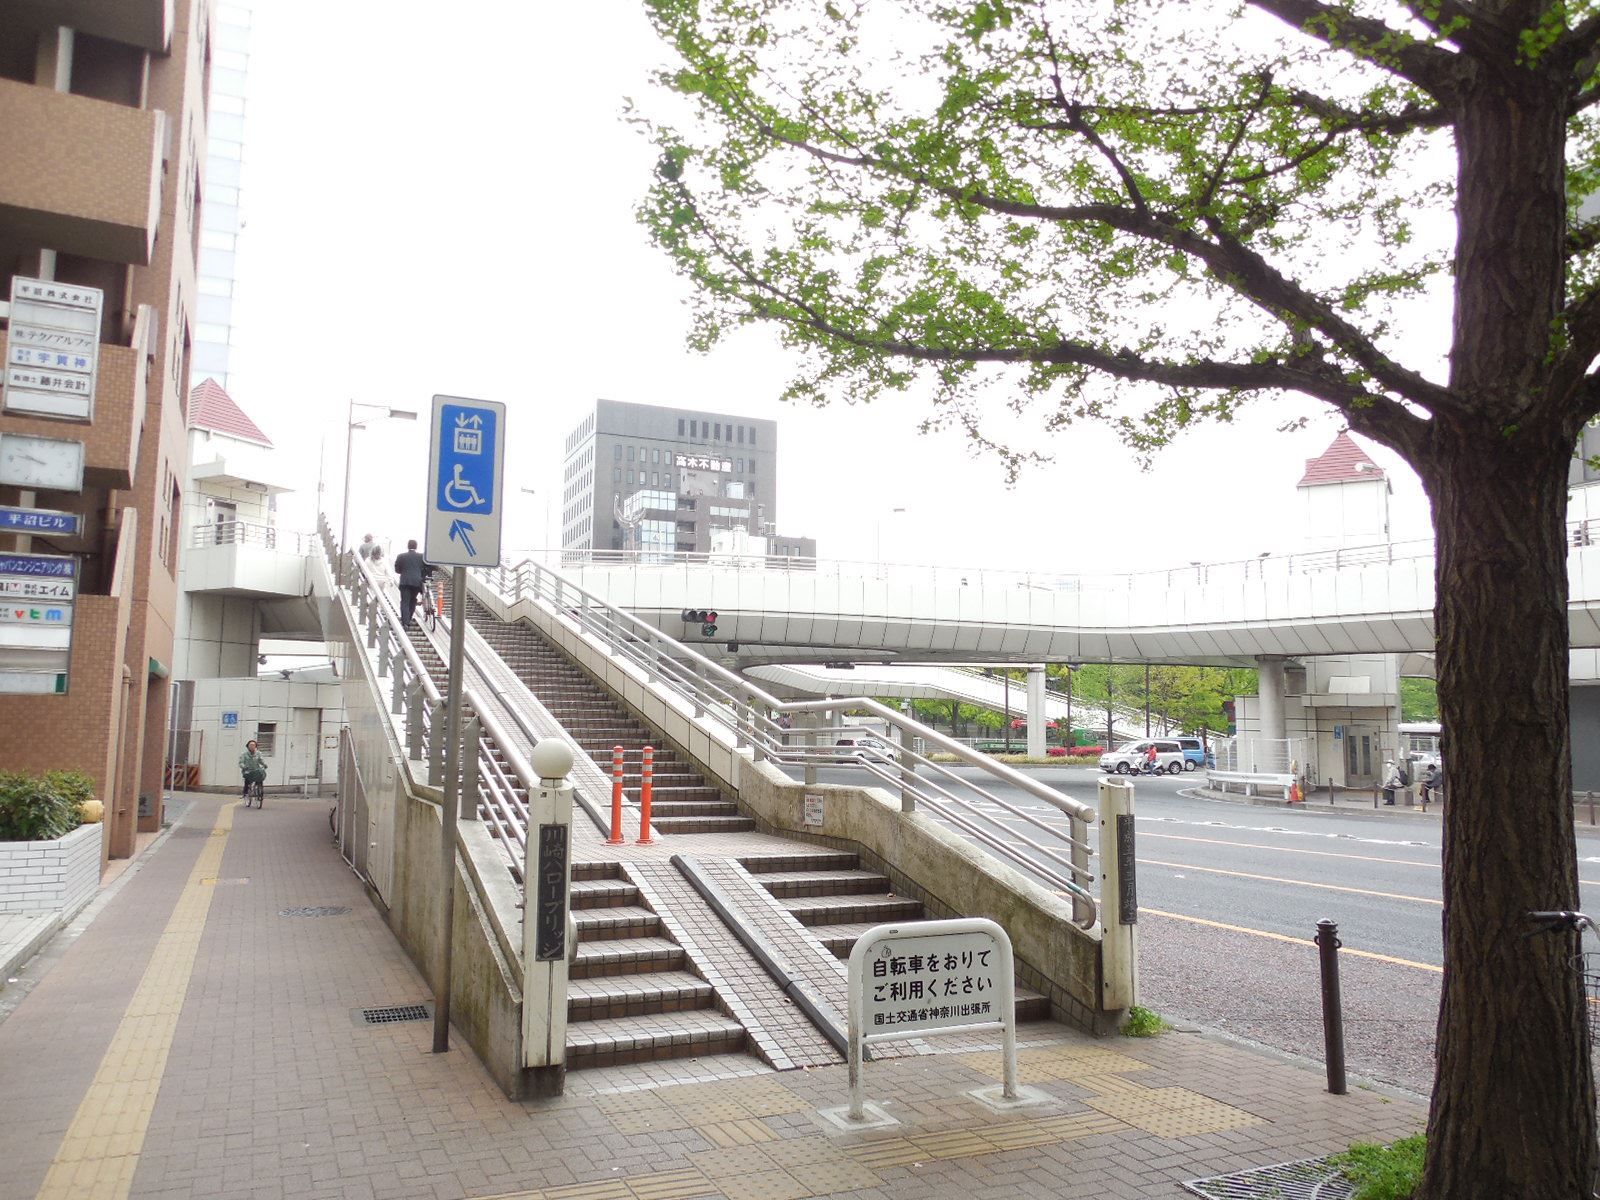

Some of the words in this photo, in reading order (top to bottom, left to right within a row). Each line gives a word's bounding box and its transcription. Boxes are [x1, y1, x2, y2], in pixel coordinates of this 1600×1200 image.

[676, 455, 732, 473] 高木不動産
[8, 513, 66, 528] 平沼ビル
[543, 827, 564, 958] 川崎ハローブリッジ
[873, 949, 992, 978] 自転車をおりて
[873, 976, 992, 1002] ご利用ください
[874, 1001, 991, 1026] 国土交通省神奈川出張所
